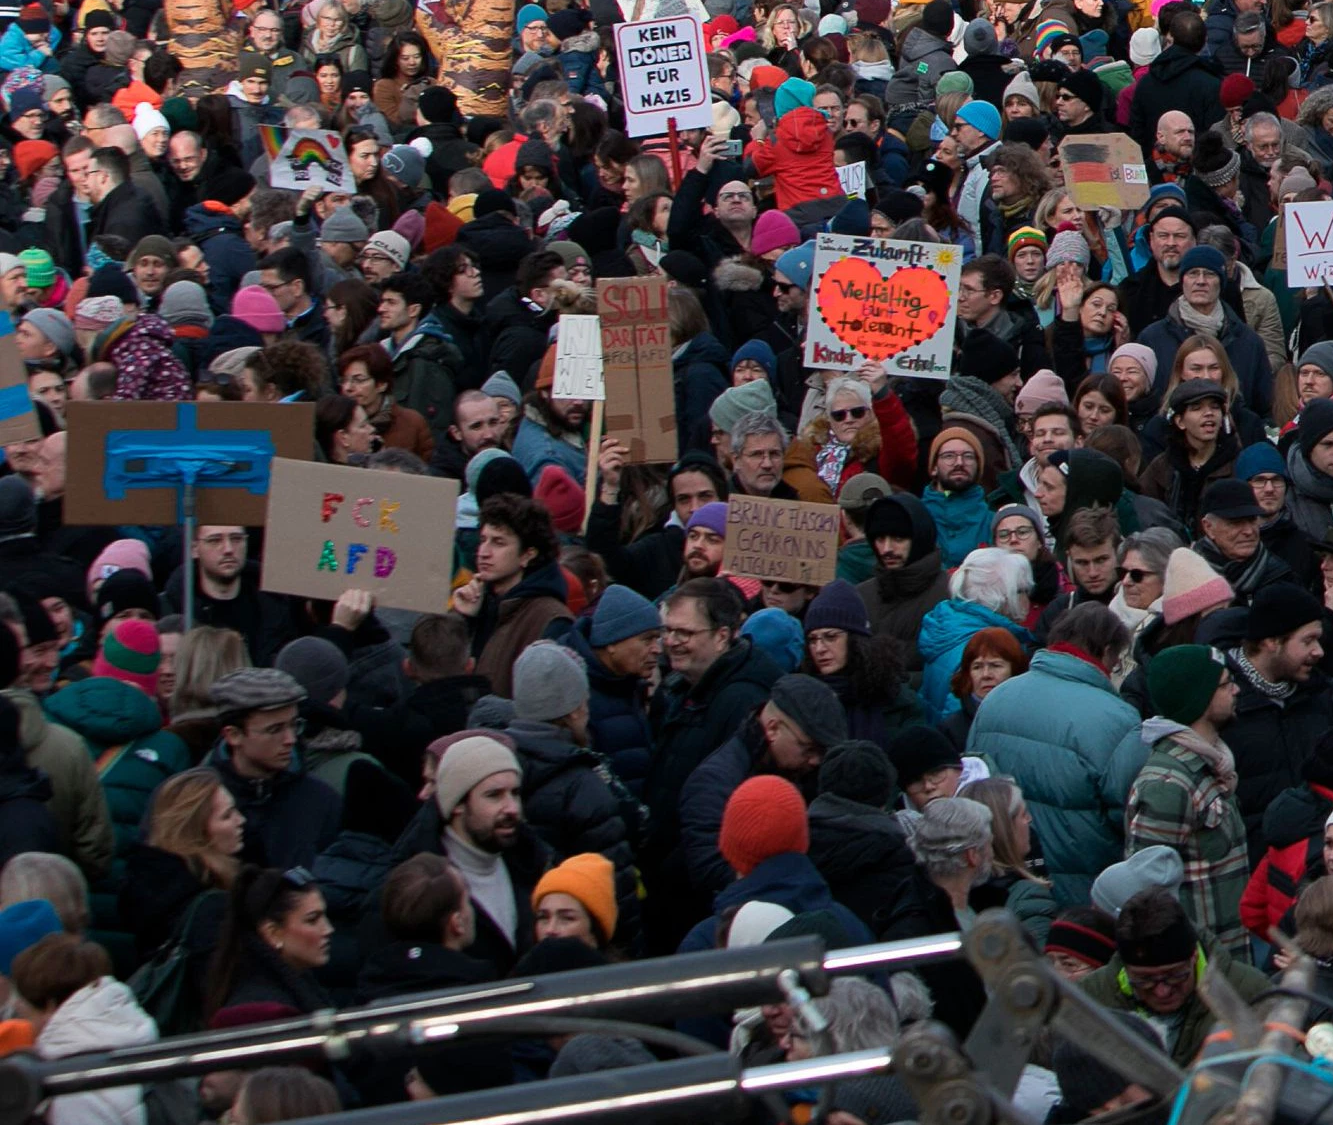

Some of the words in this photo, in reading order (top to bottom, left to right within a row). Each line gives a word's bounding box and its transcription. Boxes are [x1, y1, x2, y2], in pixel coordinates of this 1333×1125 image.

[638, 24, 677, 43] KEIN
[630, 46, 691, 67] DÖNER
[647, 67, 680, 85] FÜR
[640, 87, 692, 108] NAZIS
[602, 283, 669, 324] SOLI
[832, 279, 930, 319] Vielfältig
[602, 324, 668, 349] DARITÄT
[837, 312, 922, 340] tolerant
[812, 341, 857, 366] Kinder
[320, 491, 401, 533] FCK
[316, 539, 398, 578] AFD
